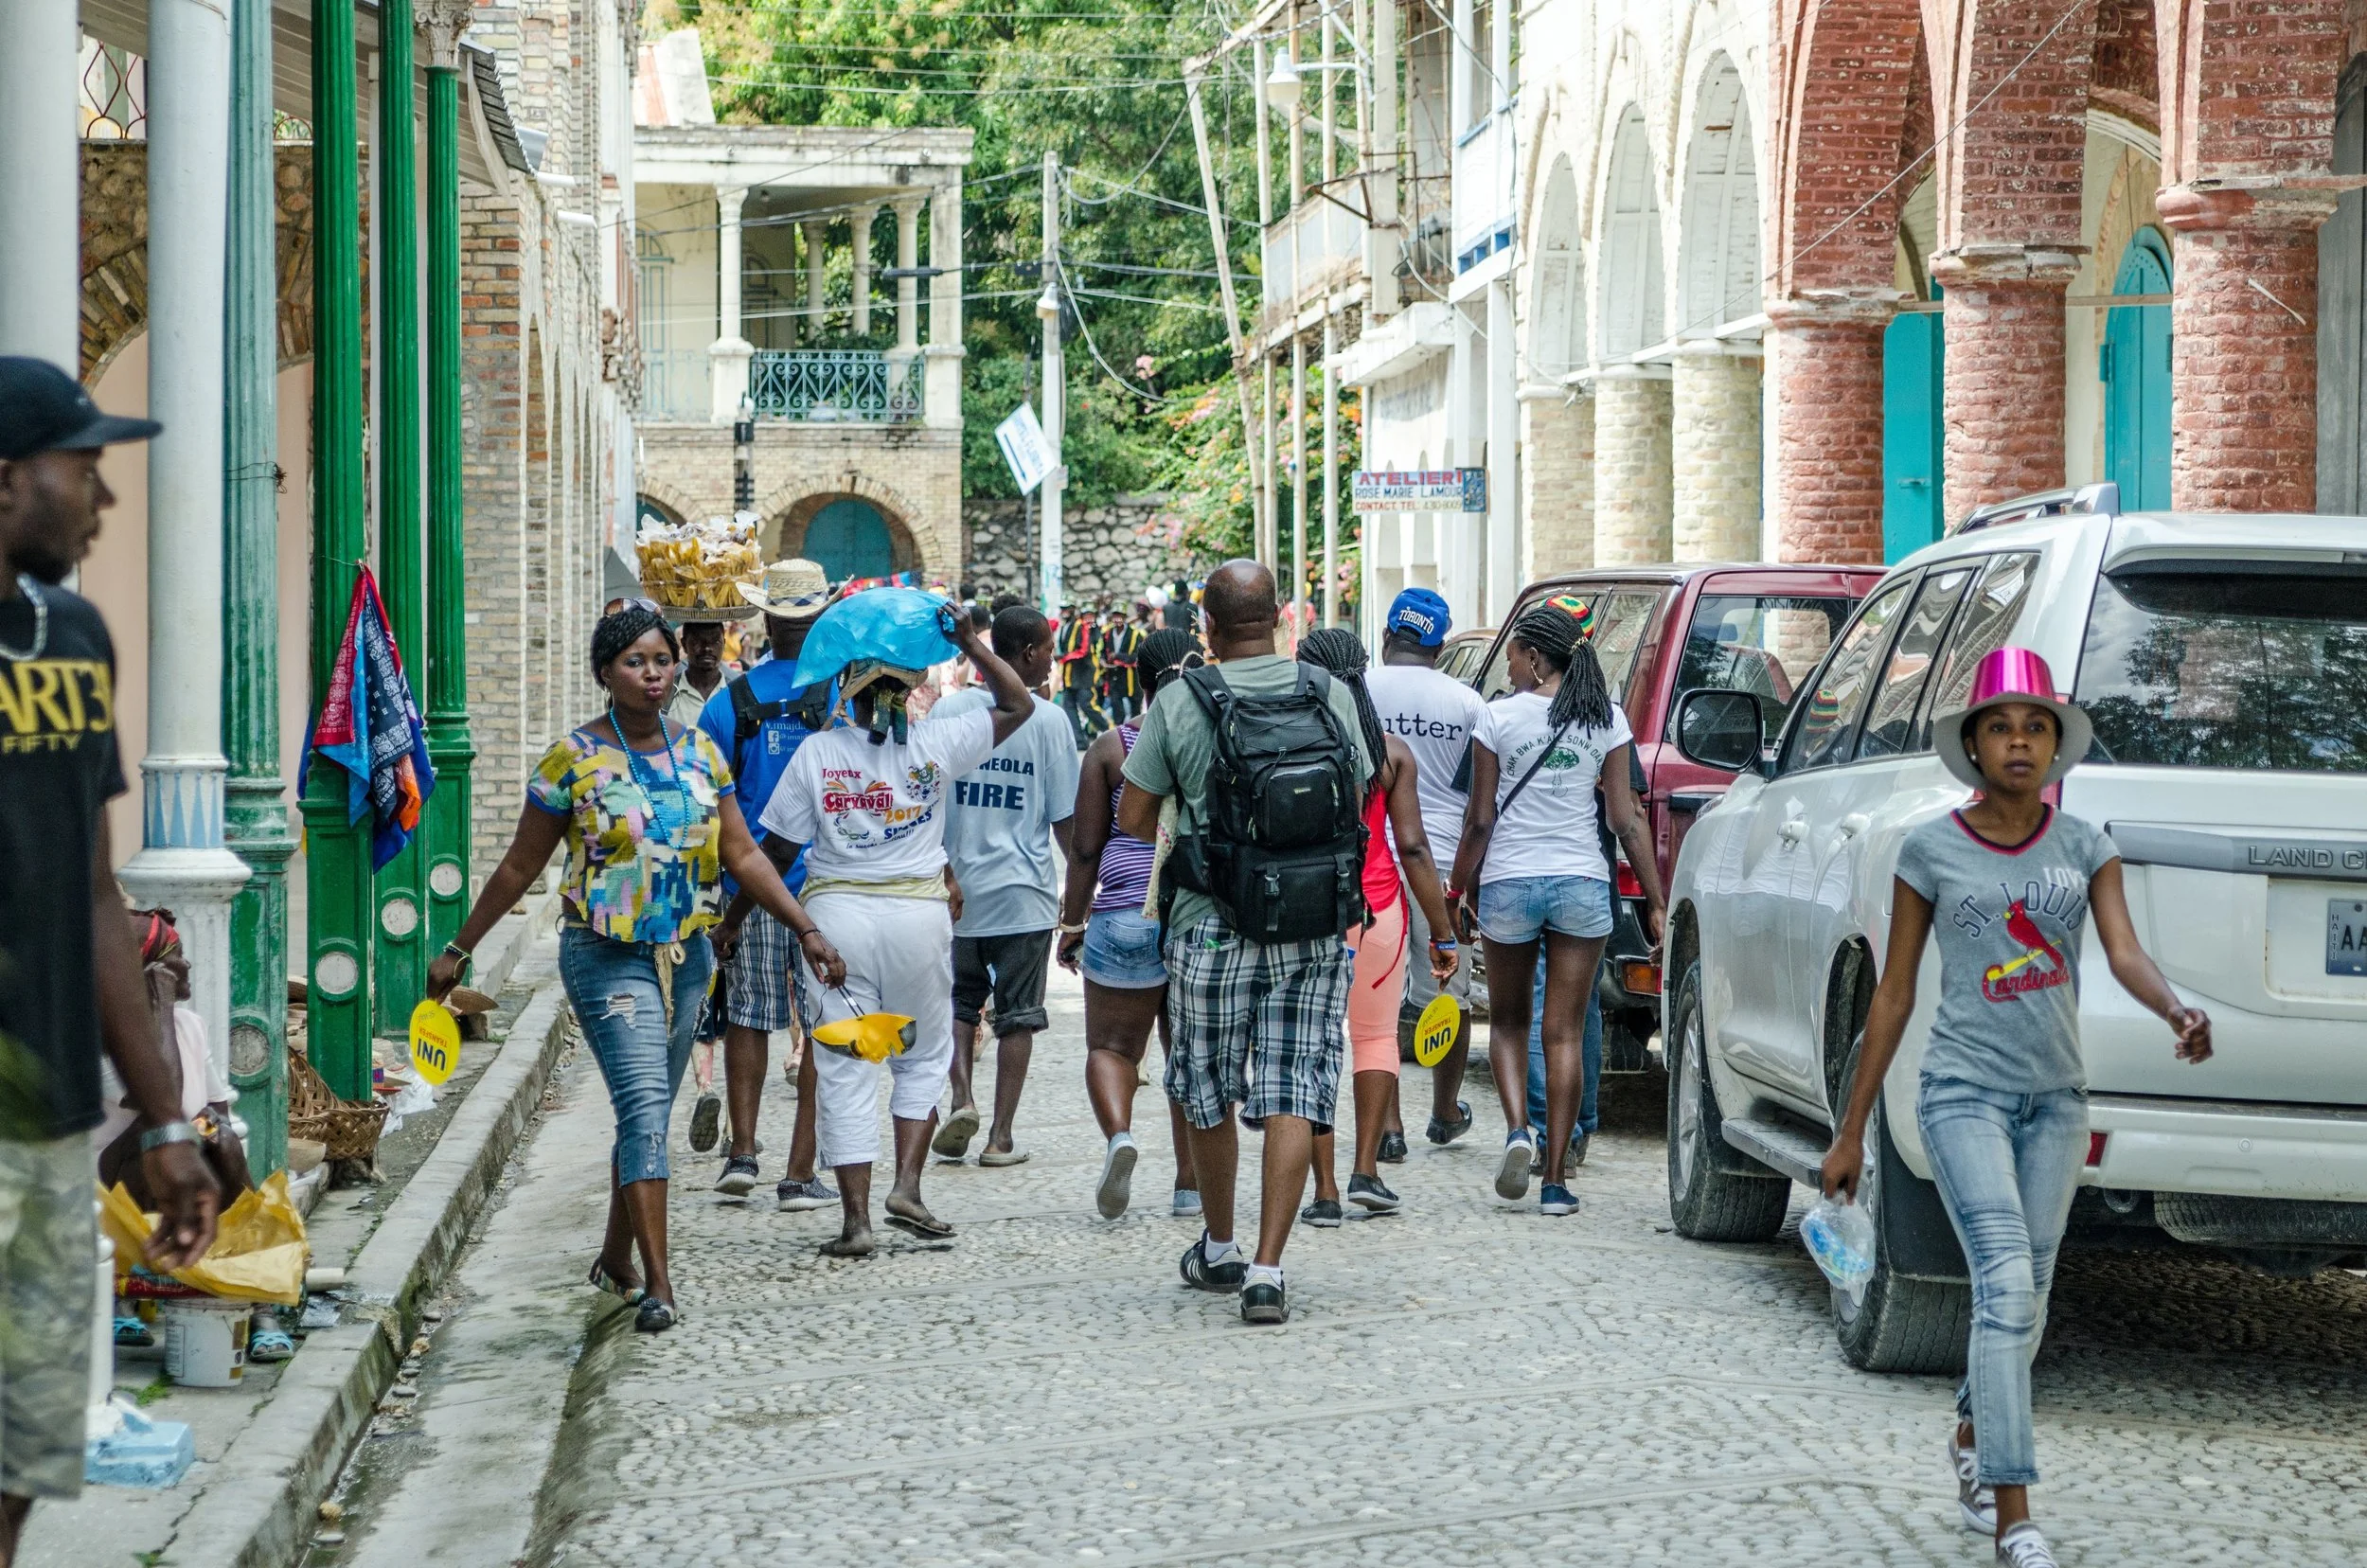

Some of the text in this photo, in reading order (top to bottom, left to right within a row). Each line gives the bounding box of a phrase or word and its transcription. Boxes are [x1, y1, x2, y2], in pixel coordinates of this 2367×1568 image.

[1355, 488, 1379, 499] ROSE
[1384, 487, 1414, 499] MARIE
[1355, 501, 1397, 511] CONTACT
[1399, 606, 1434, 635] TORONTO
[2, 733, 82, 754] FIFTY
[1507, 756, 1520, 776] CHAK
[1516, 741, 1535, 757] BWA
[822, 768, 862, 780] Joyeux
[955, 780, 1024, 811] FIRE
[884, 805, 922, 825] 2017
[2249, 846, 2367, 870] LAND C
[2331, 914, 2340, 960] HAITI
[418, 1026, 448, 1048] TRANSFER
[1424, 1016, 1451, 1036] TRANSFER
[1424, 1026, 1451, 1056] UNI
[417, 1038, 446, 1071] UNI
